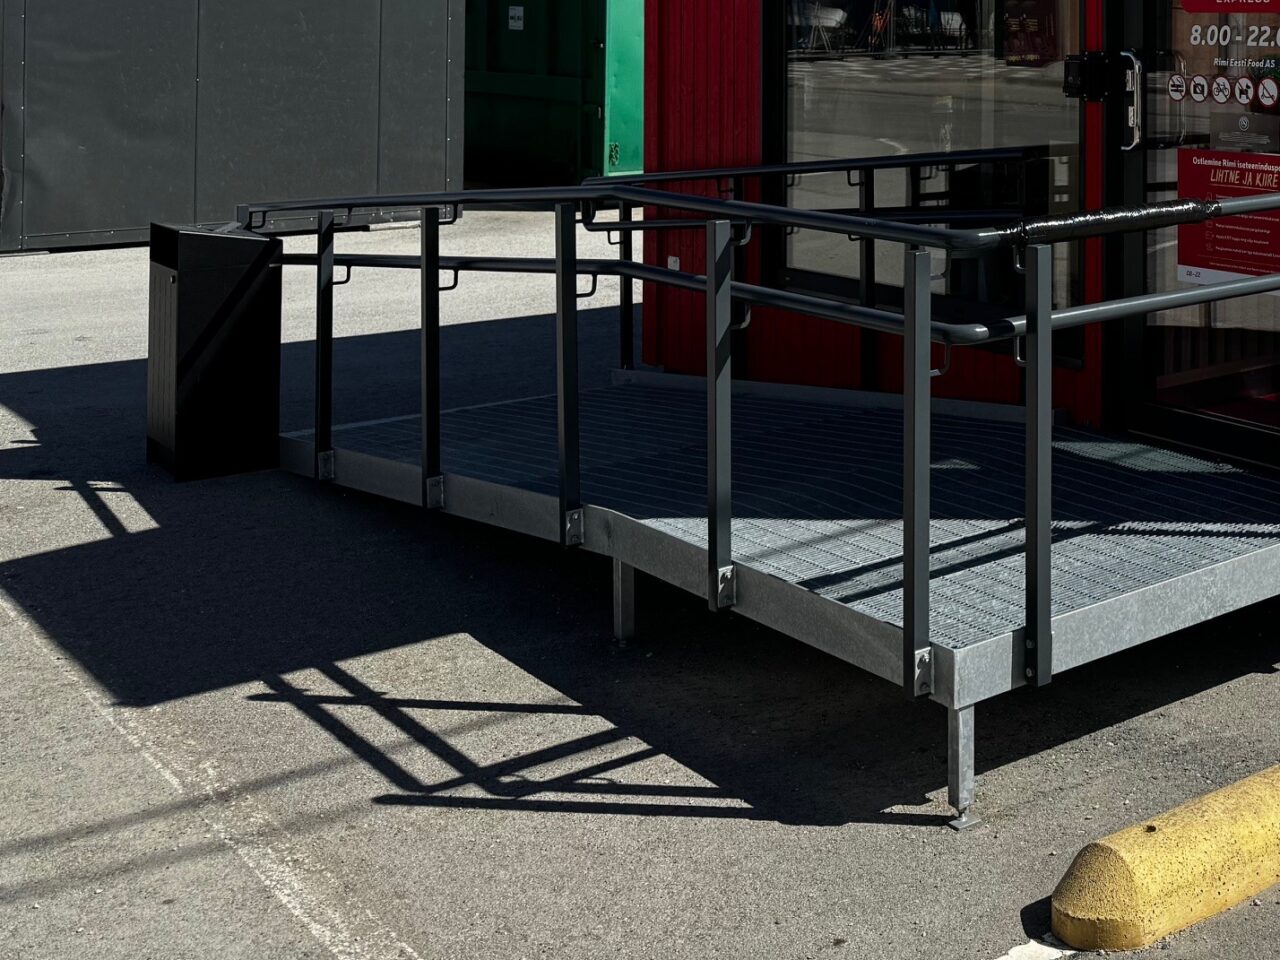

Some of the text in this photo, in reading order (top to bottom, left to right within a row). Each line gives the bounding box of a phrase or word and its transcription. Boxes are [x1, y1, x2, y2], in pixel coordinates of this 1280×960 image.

[1190, 25, 1231, 46] 8.00
[1213, 57, 1275, 68] Rimi Eesti Food AS
[1222, 159, 1236, 168] Rimi
[1210, 168, 1279, 188] LIHTNE JA KIIRE
